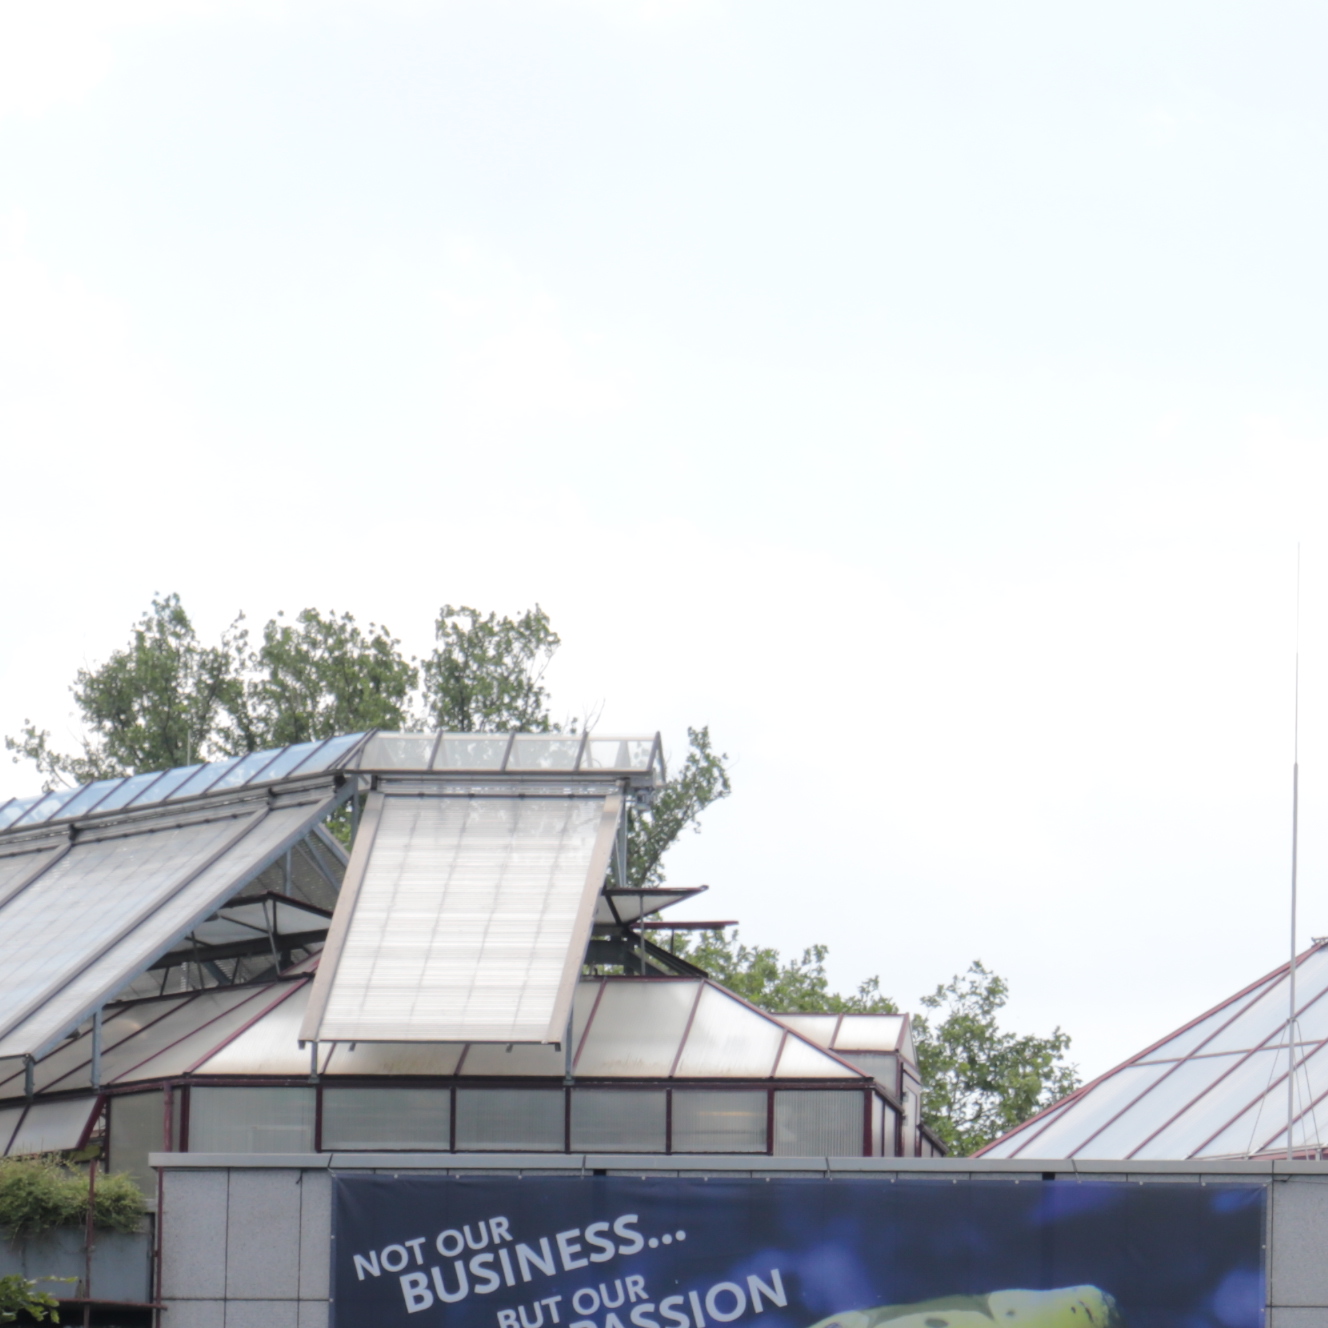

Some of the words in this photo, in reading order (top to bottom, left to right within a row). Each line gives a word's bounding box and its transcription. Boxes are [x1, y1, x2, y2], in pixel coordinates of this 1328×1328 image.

[353, 1237, 426, 1281] NOT
[436, 1216, 513, 1258] OUR
[399, 1214, 686, 1314] BUSINESS...
[572, 1274, 649, 1315] OUR
